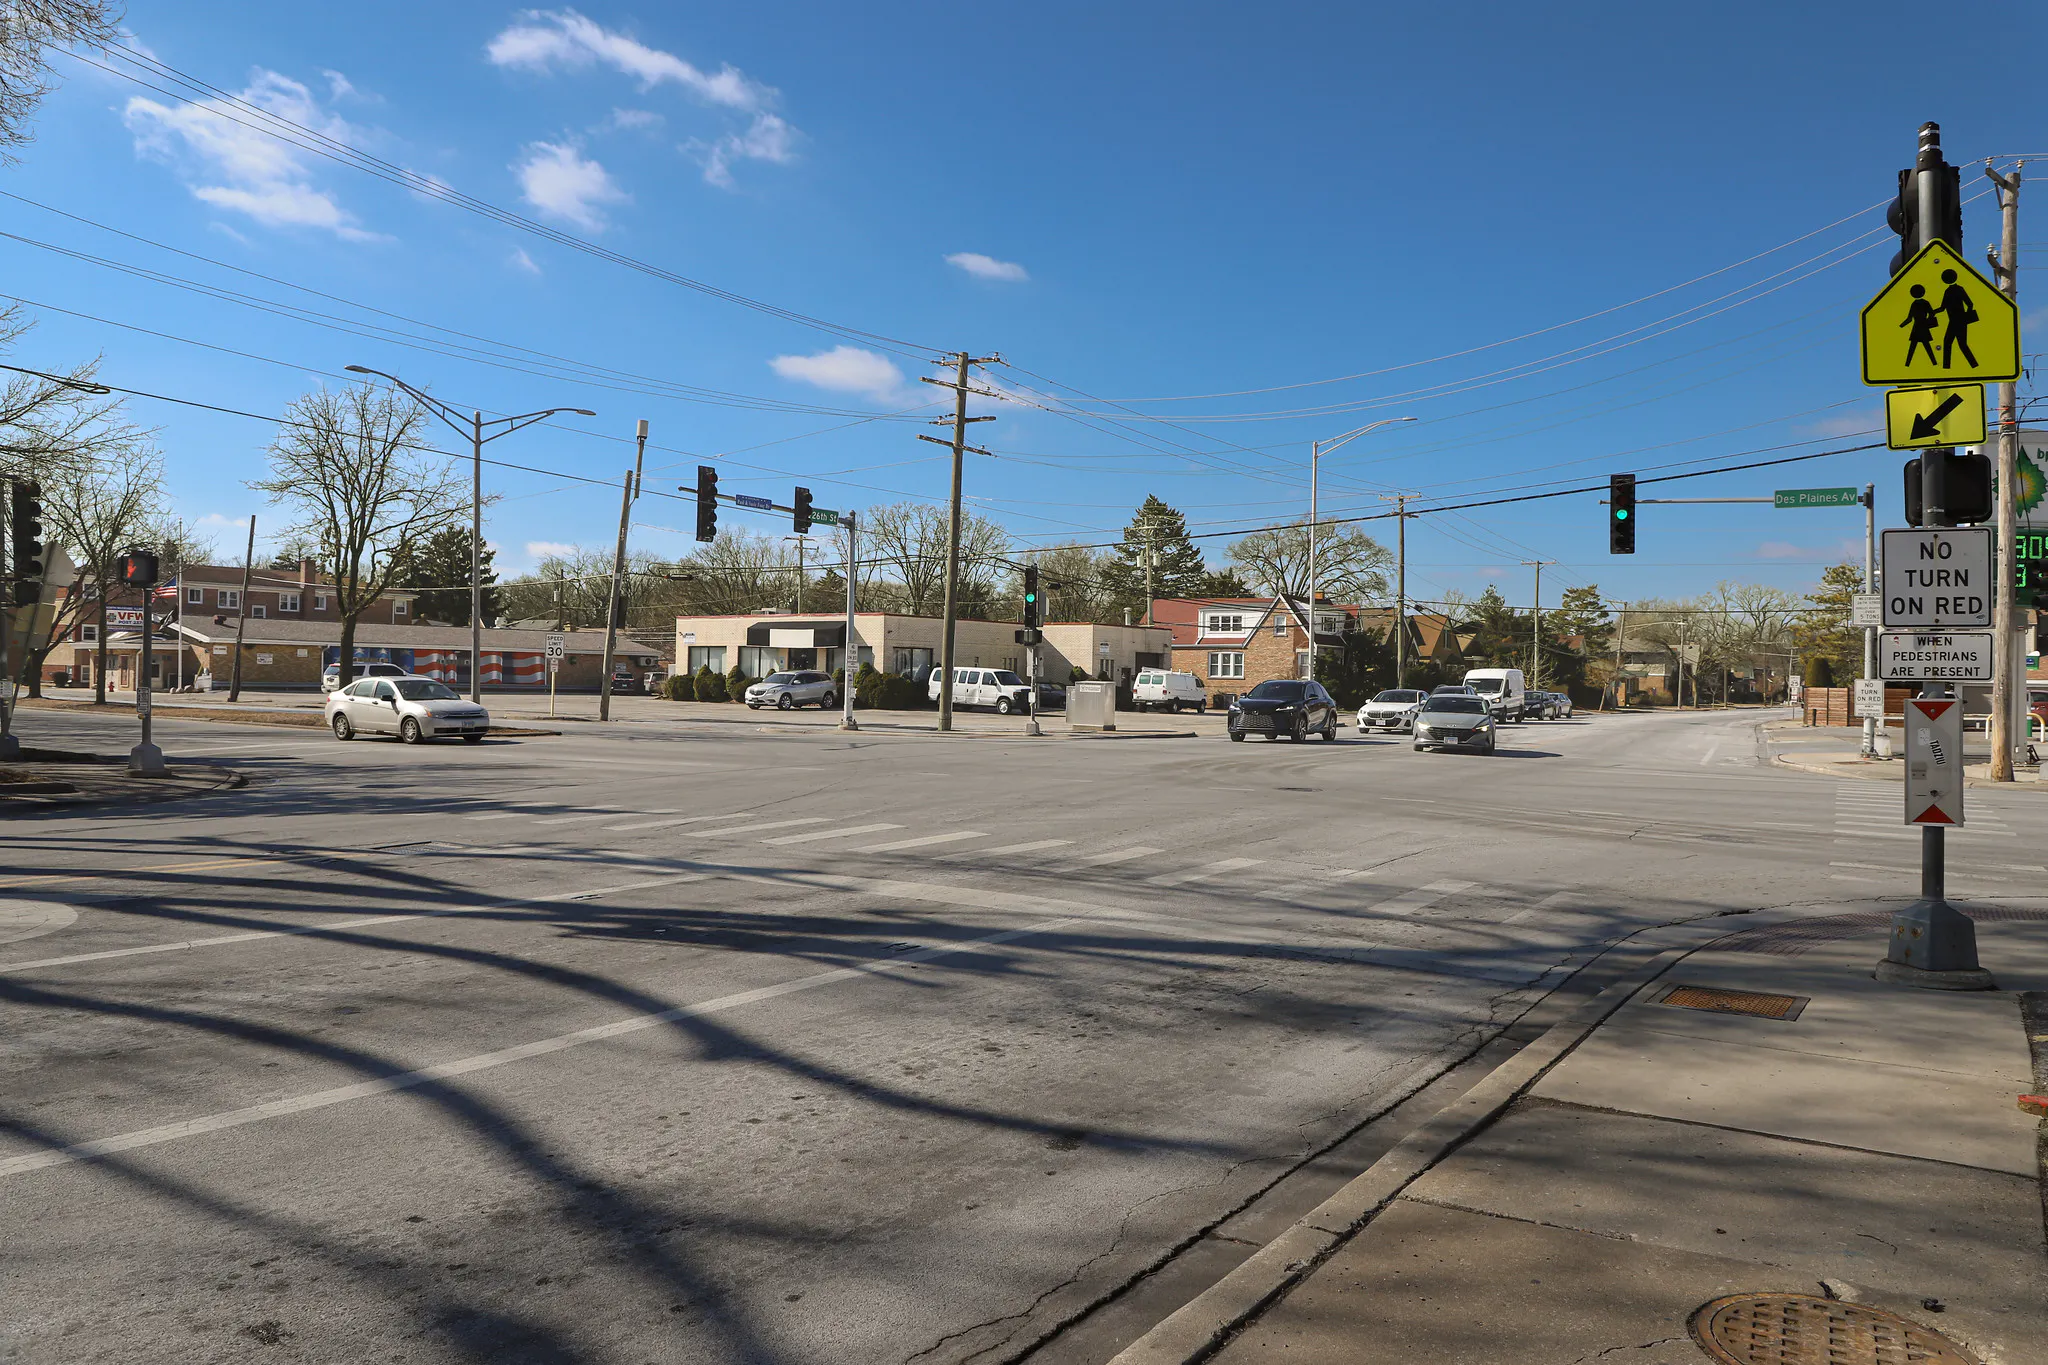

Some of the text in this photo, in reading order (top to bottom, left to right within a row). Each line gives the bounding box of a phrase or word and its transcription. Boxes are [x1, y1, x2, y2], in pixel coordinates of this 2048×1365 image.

[1776, 491, 1856, 504] Des Plaines Av
[812, 511, 838, 523] 26th St
[1920, 541, 1952, 560] NO
[1905, 569, 1968, 587] TURN
[1891, 596, 1983, 615] ON RED
[118, 611, 143, 620] VFW
[1917, 636, 1952, 646] WHEN
[548, 647, 562, 656] 30
[1893, 651, 1977, 661] PEDESTRIANS
[1890, 667, 1981, 677] ARE PRESENT
[1929, 738, 1946, 766] TADZIU
